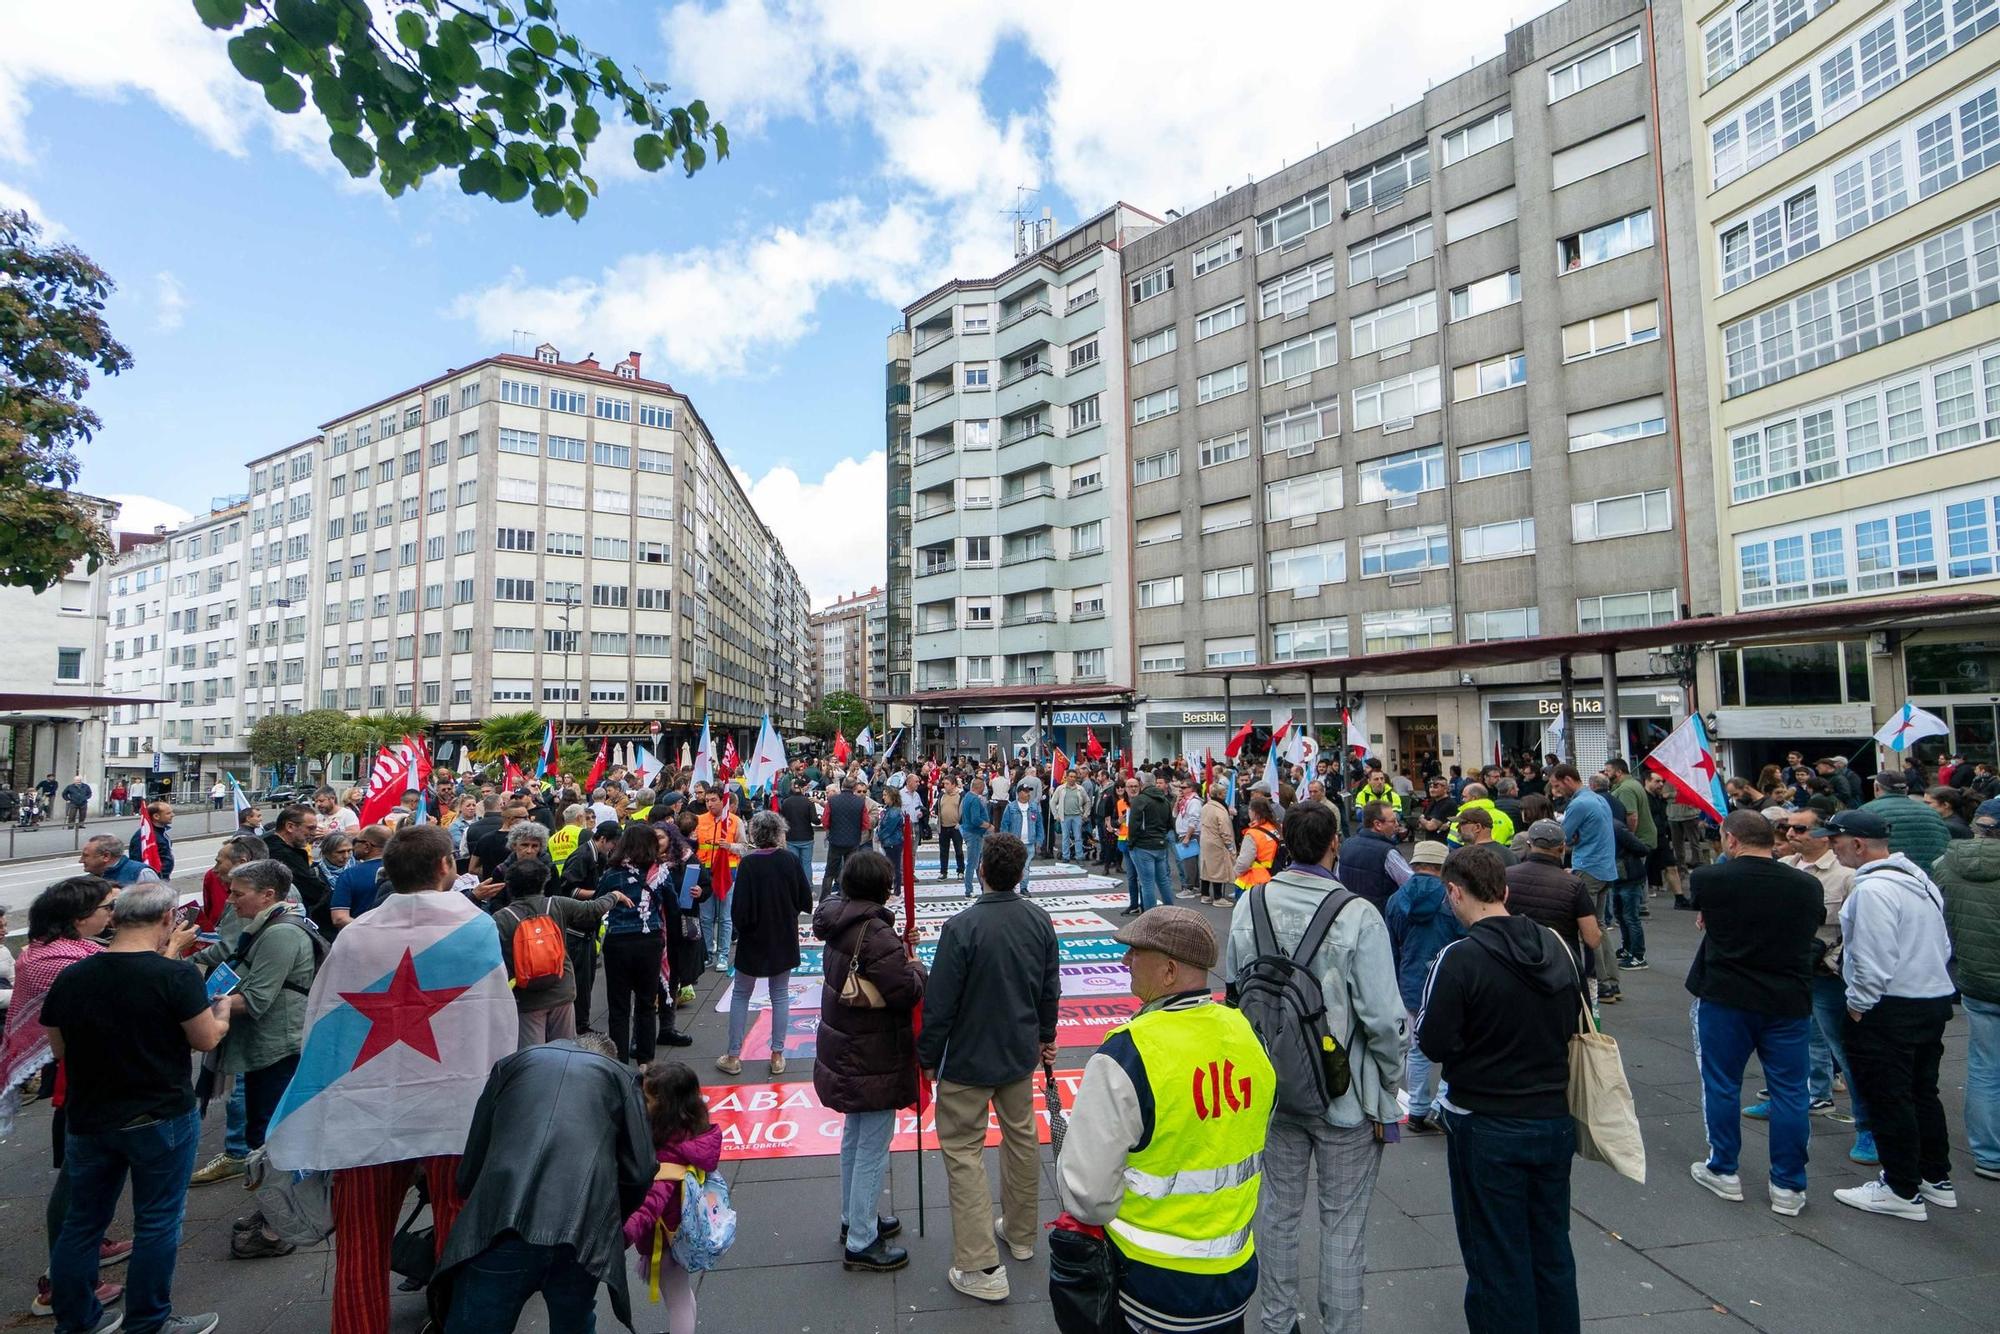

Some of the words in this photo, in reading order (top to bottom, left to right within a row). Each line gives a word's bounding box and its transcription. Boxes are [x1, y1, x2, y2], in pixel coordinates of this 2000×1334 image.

[1539, 698, 1600, 714] Berhka
[1183, 712, 1226, 723] Bershka
[594, 724, 651, 735] KRYSTA
[1193, 1059, 1251, 1121] CIG
[722, 1120, 799, 1145] AIO
